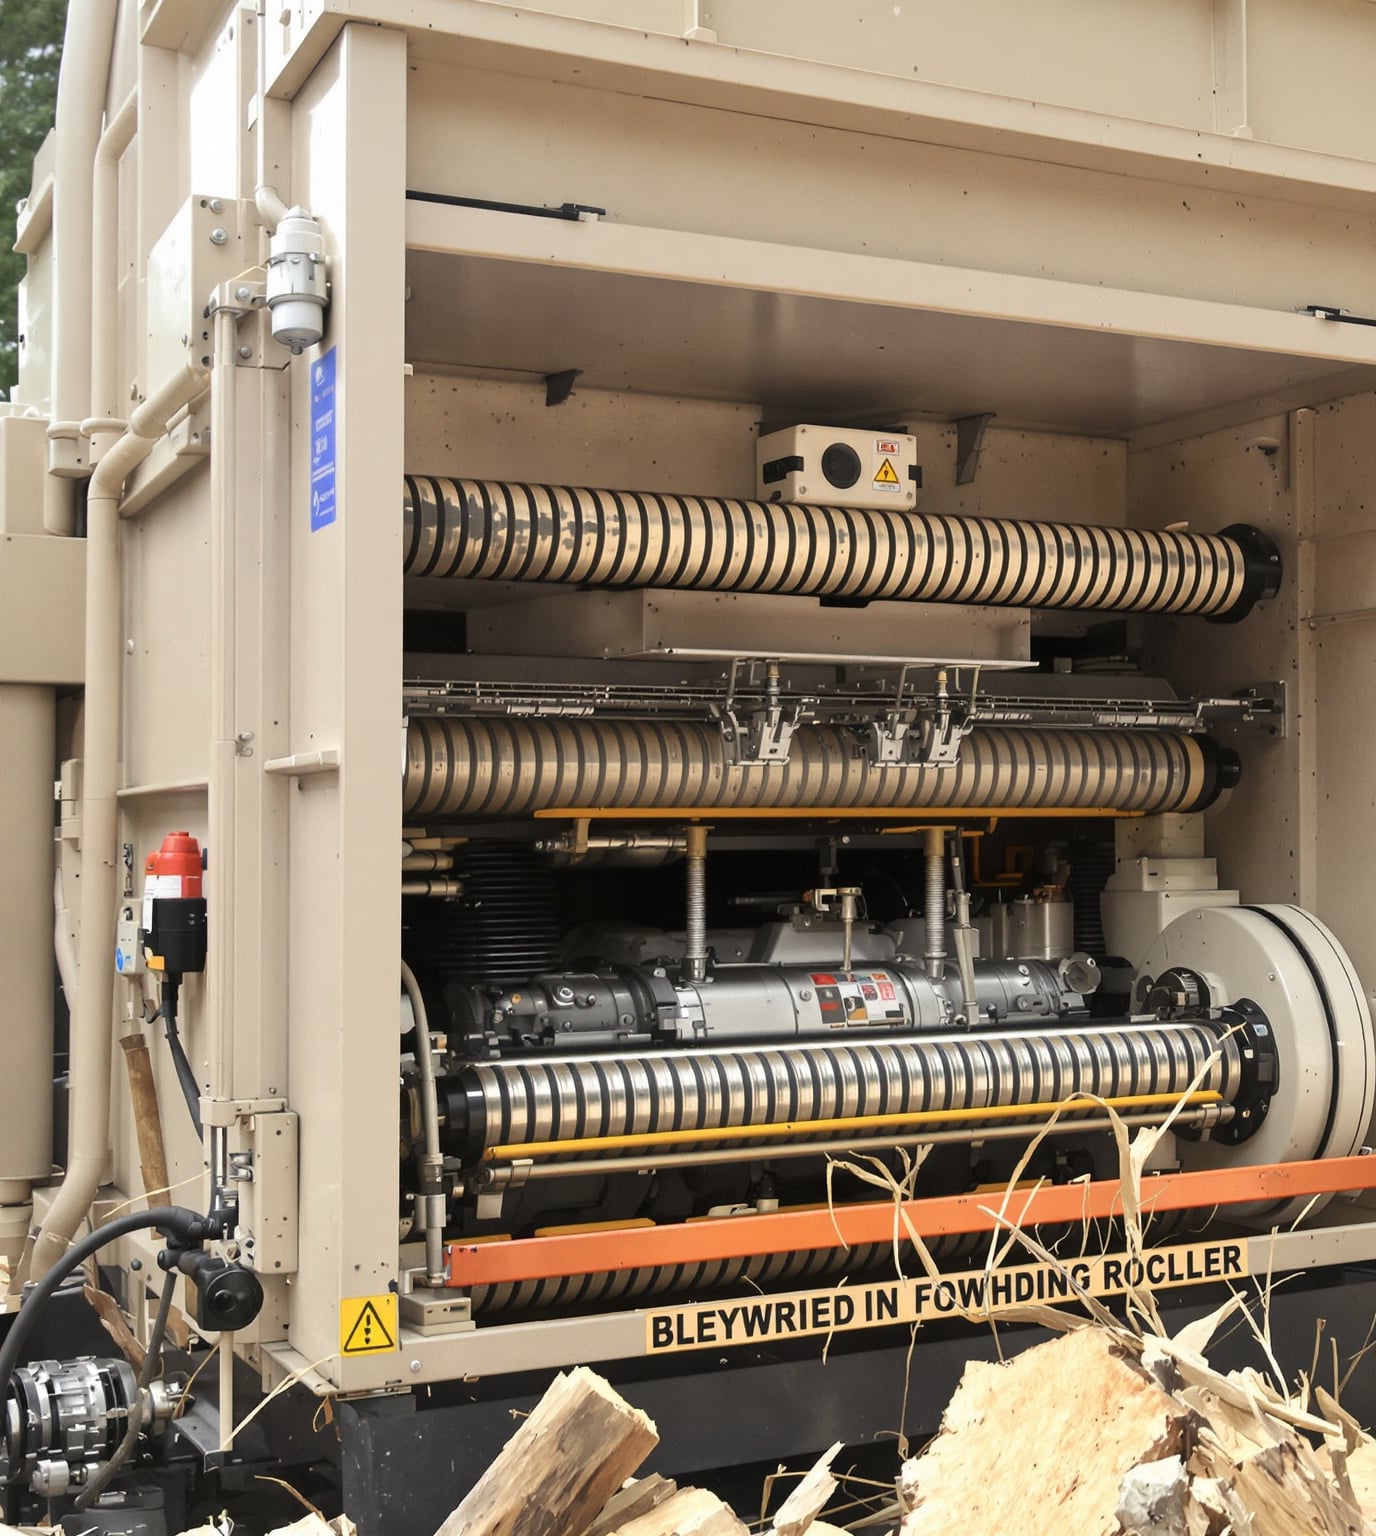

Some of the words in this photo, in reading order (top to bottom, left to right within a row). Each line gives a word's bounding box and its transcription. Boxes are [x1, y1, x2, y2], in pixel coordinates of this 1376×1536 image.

[652, 1294, 855, 1348] BLEYWRIED
[865, 1287, 898, 1322] IN
[1103, 1245, 1242, 1290] ROCLLER
